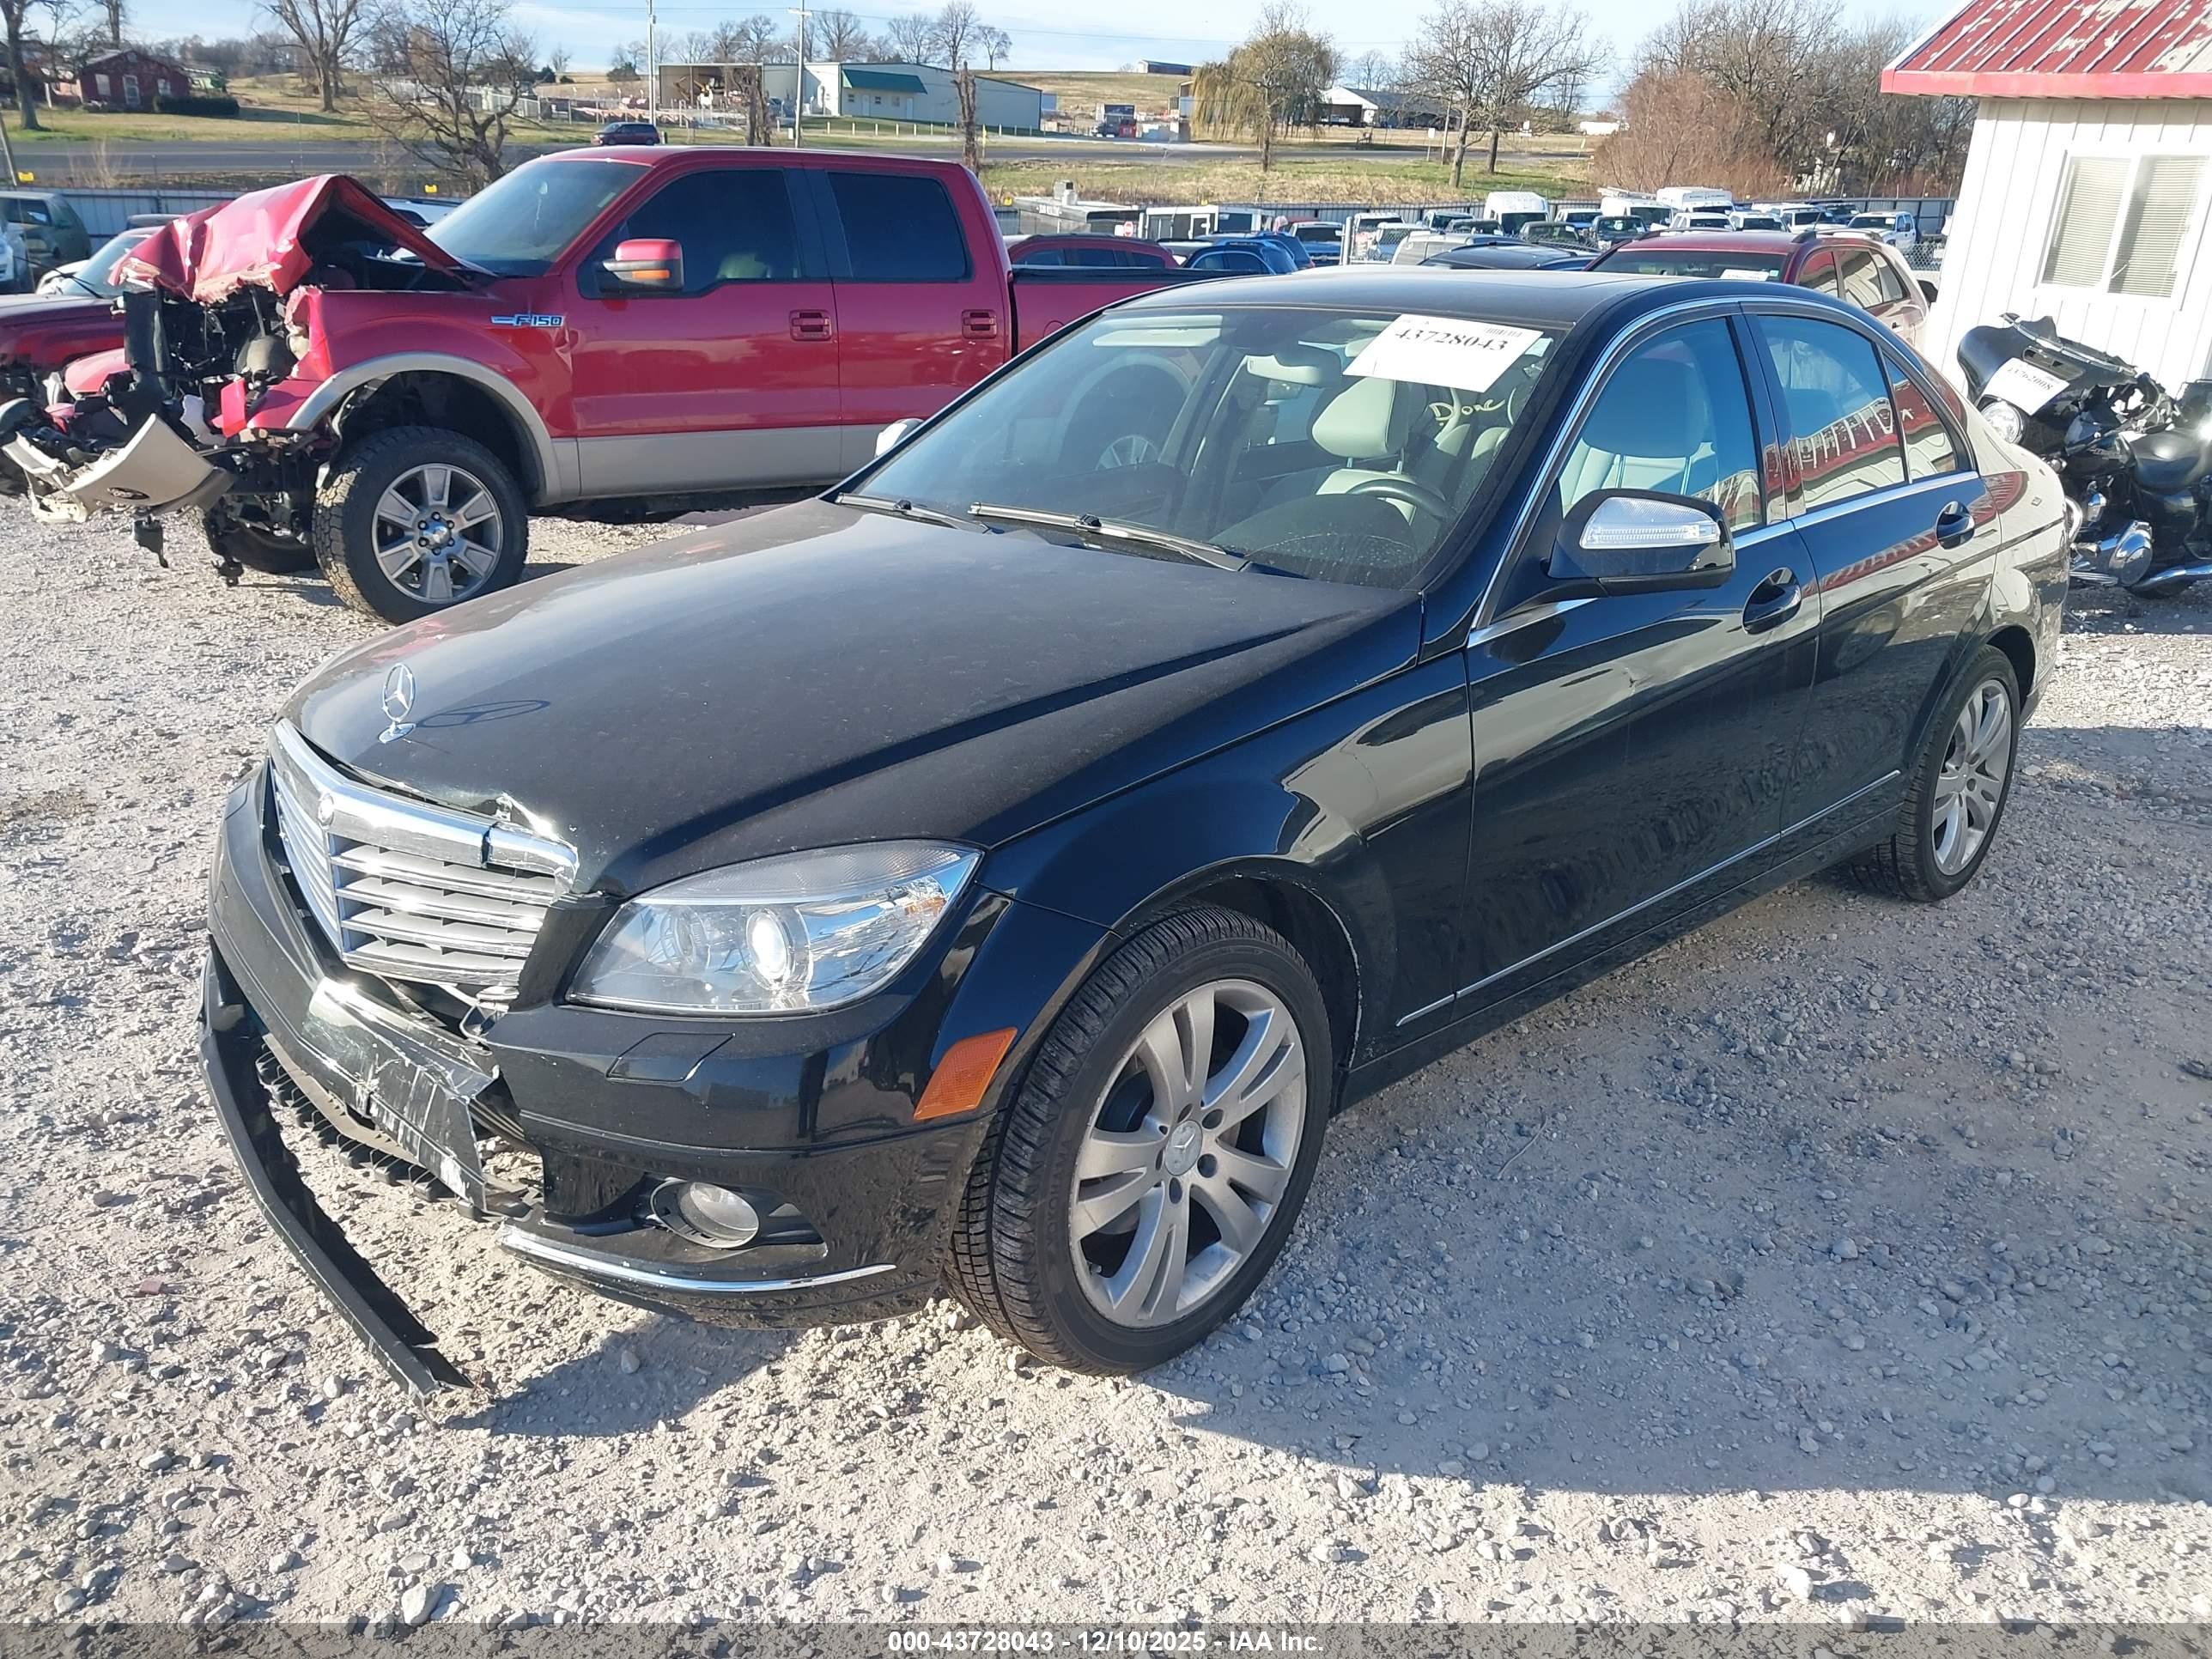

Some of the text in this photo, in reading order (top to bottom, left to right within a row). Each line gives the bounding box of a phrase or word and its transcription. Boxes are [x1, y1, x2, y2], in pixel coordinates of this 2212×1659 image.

[1395, 328, 1509, 351] 43728043
[1429, 398, 1506, 422] Done
[1046, 1139, 1073, 1248] YOKOHAMA
